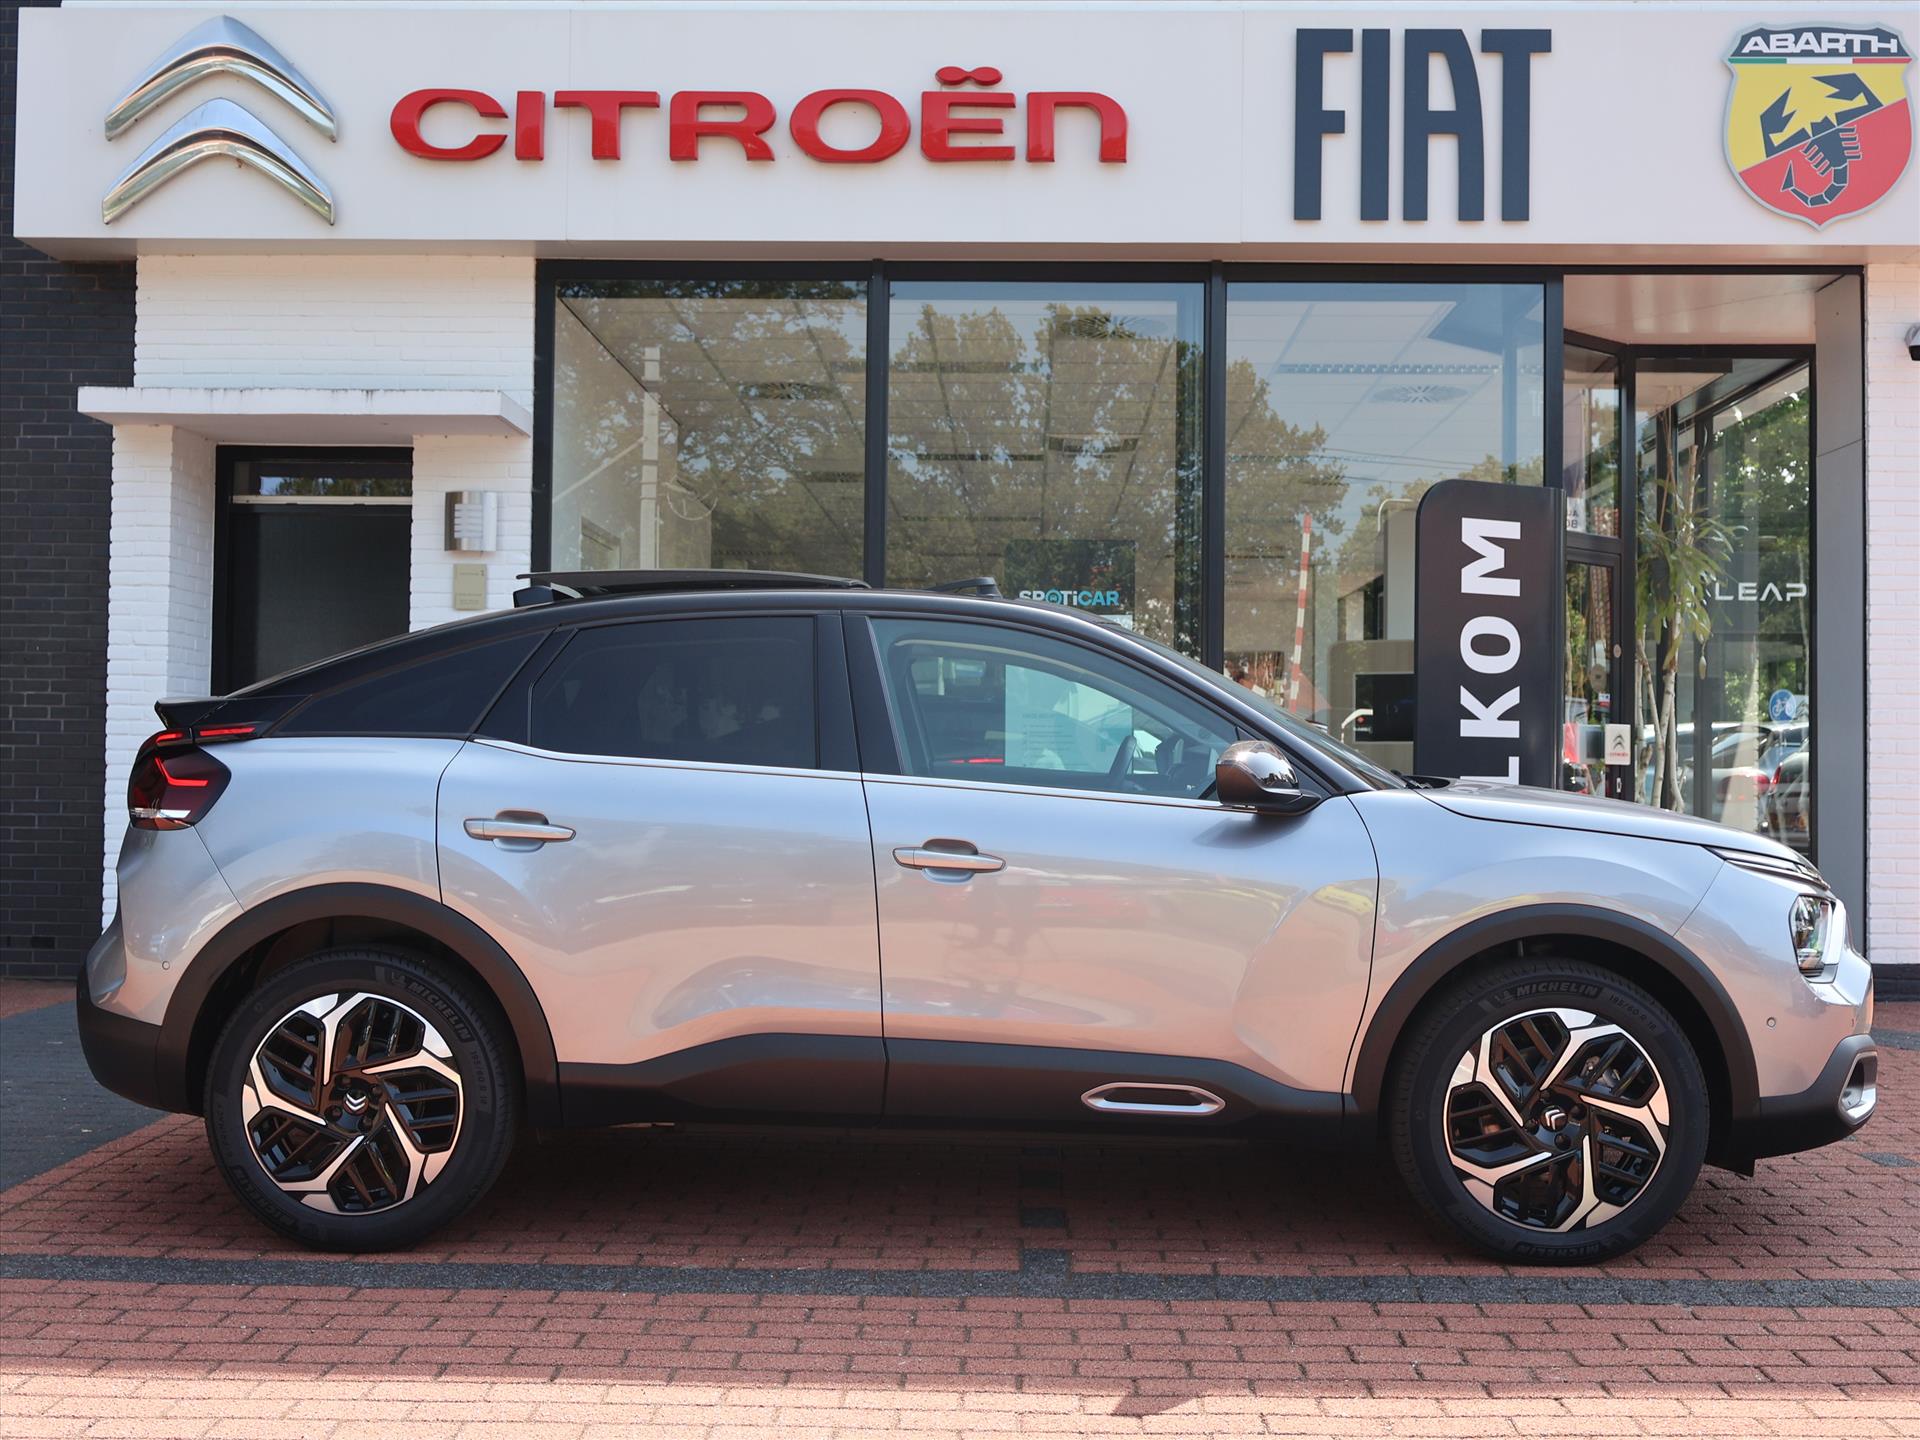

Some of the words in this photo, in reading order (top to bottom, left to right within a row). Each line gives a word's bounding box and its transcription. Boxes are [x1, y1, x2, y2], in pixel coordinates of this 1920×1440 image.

[1741, 31, 1898, 54] ABARTH
[1294, 28, 1552, 222] FIAT
[1714, 581, 1808, 602] LEAP
[1516, 981, 1598, 997] MICHELIN
[408, 981, 475, 1042] MICHELIN
